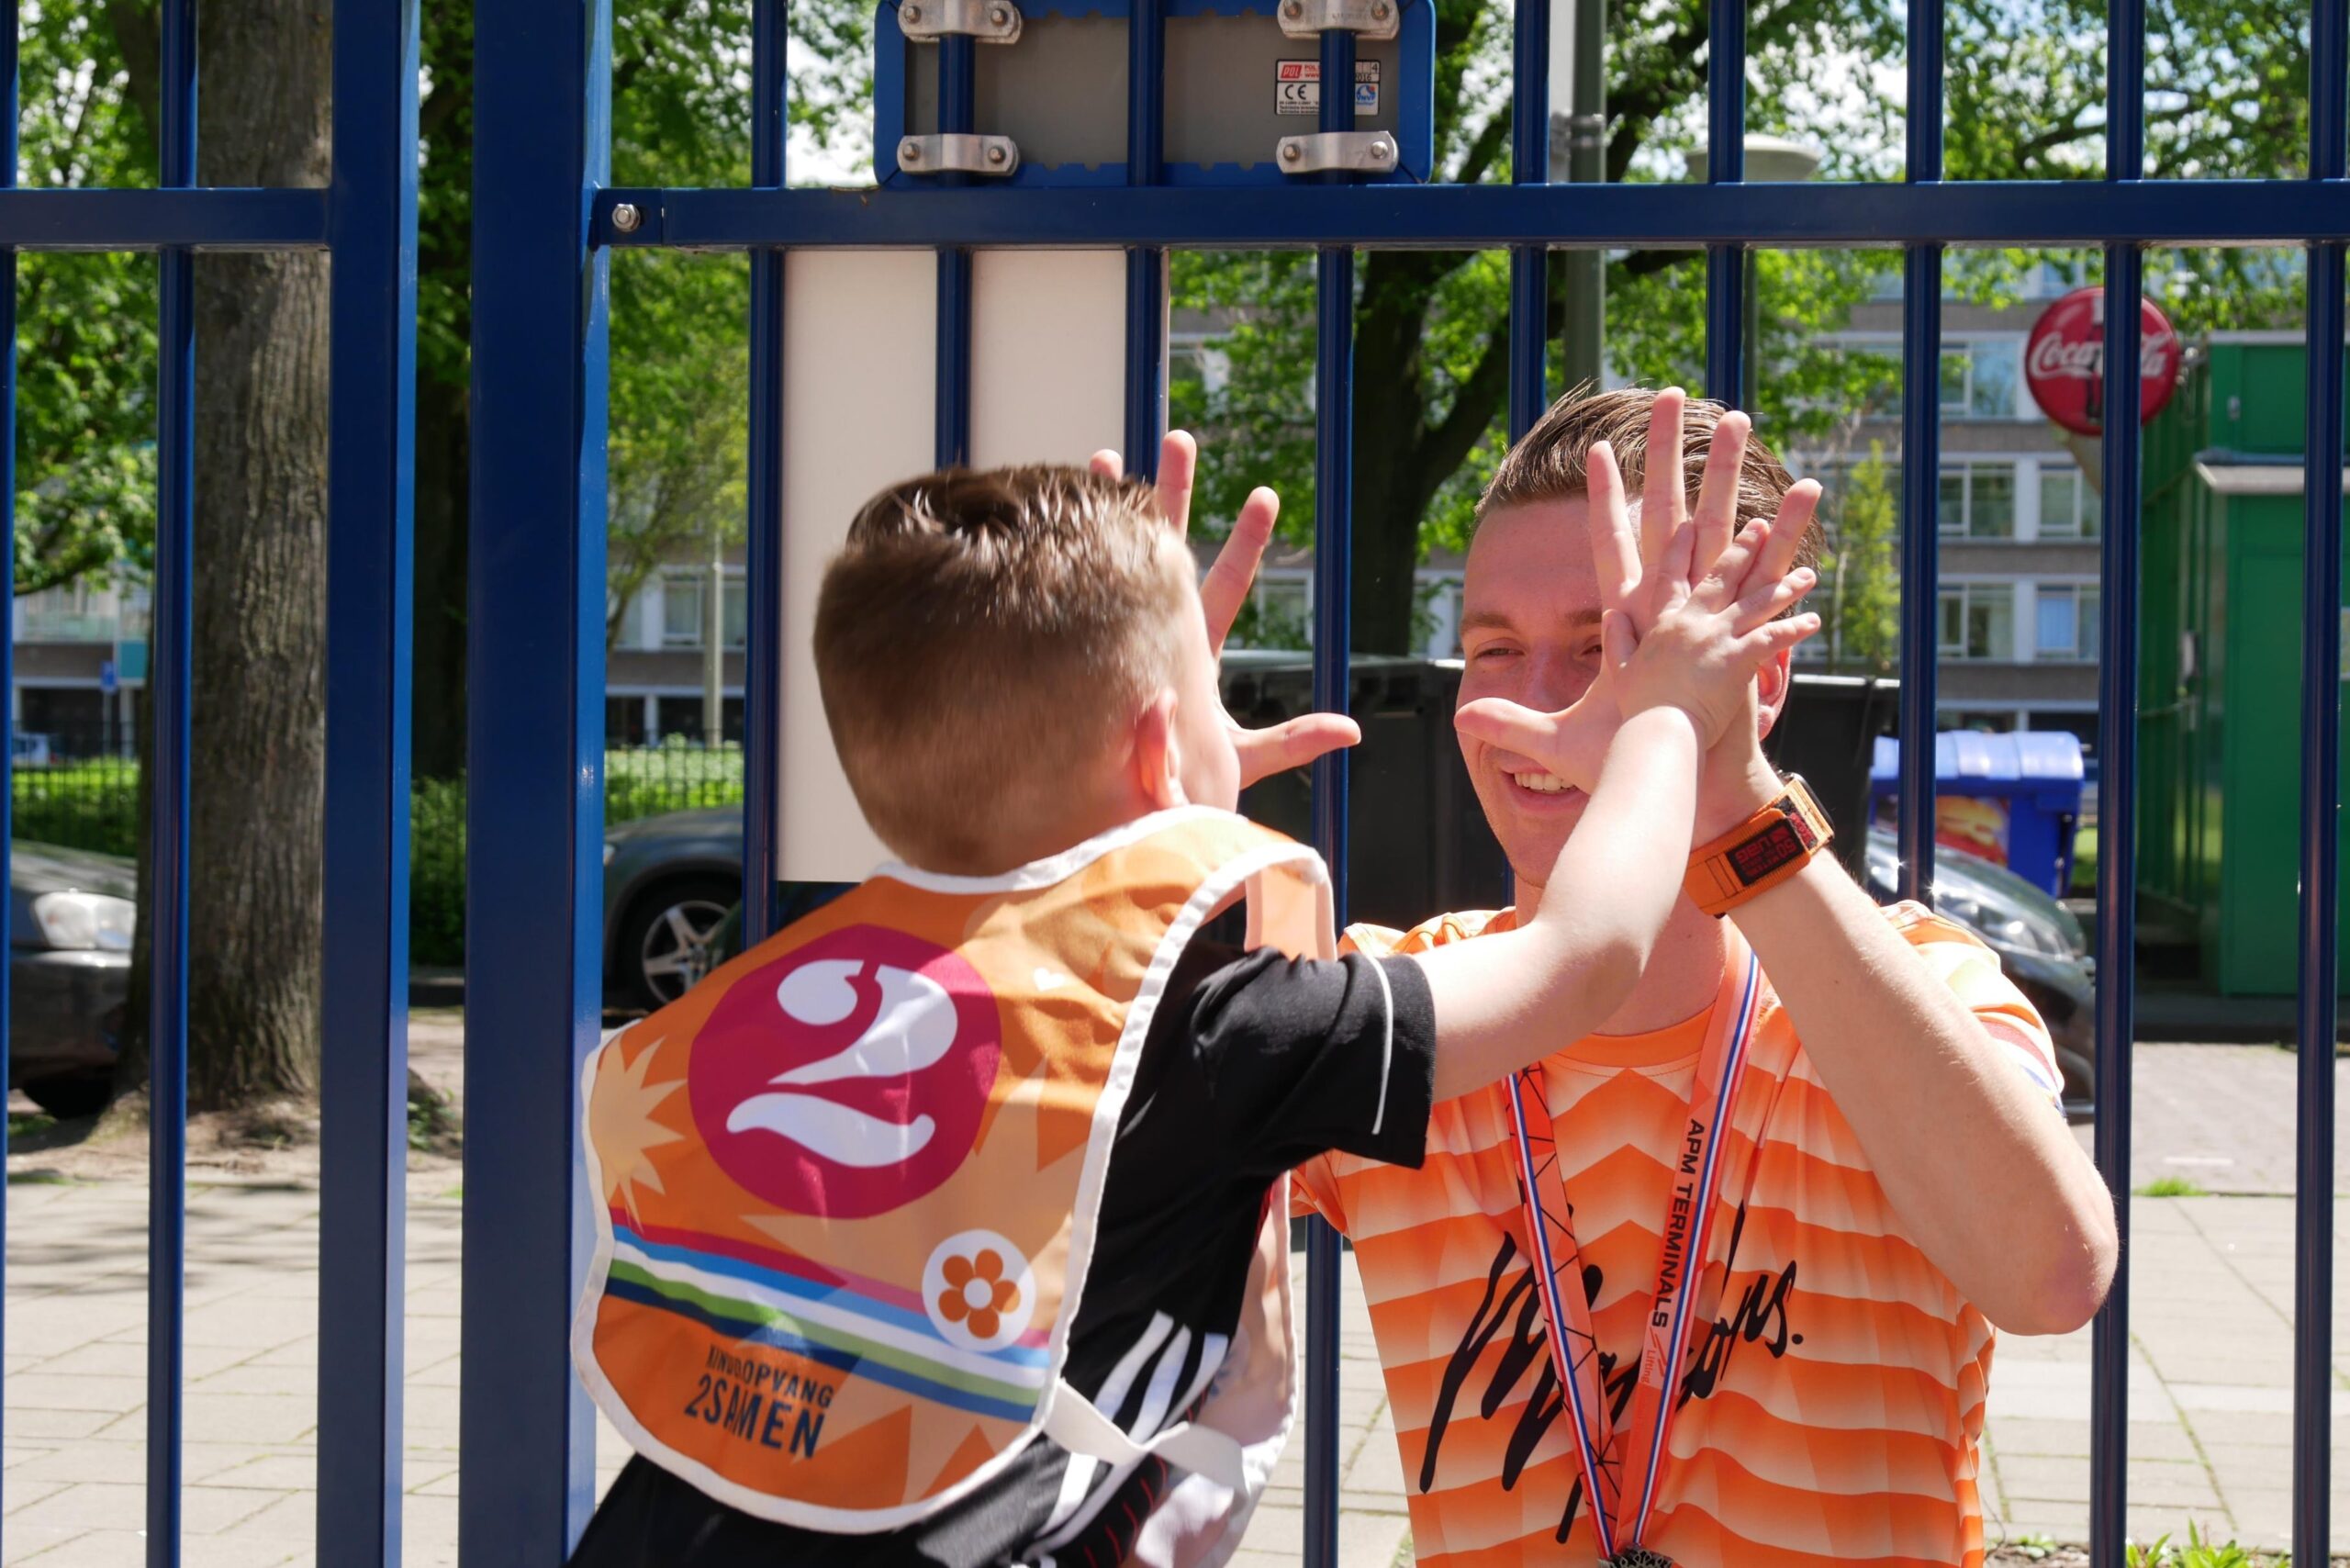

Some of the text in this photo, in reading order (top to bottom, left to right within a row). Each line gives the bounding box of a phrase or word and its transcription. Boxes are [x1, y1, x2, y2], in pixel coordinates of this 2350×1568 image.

[1282, 66, 1300, 77] POL
[1371, 63, 1378, 73] 4
[726, 958, 959, 1169] 2
[1651, 1118, 1705, 1328] APM TERMINALS
[683, 1372, 826, 1460] 2SAMEN
